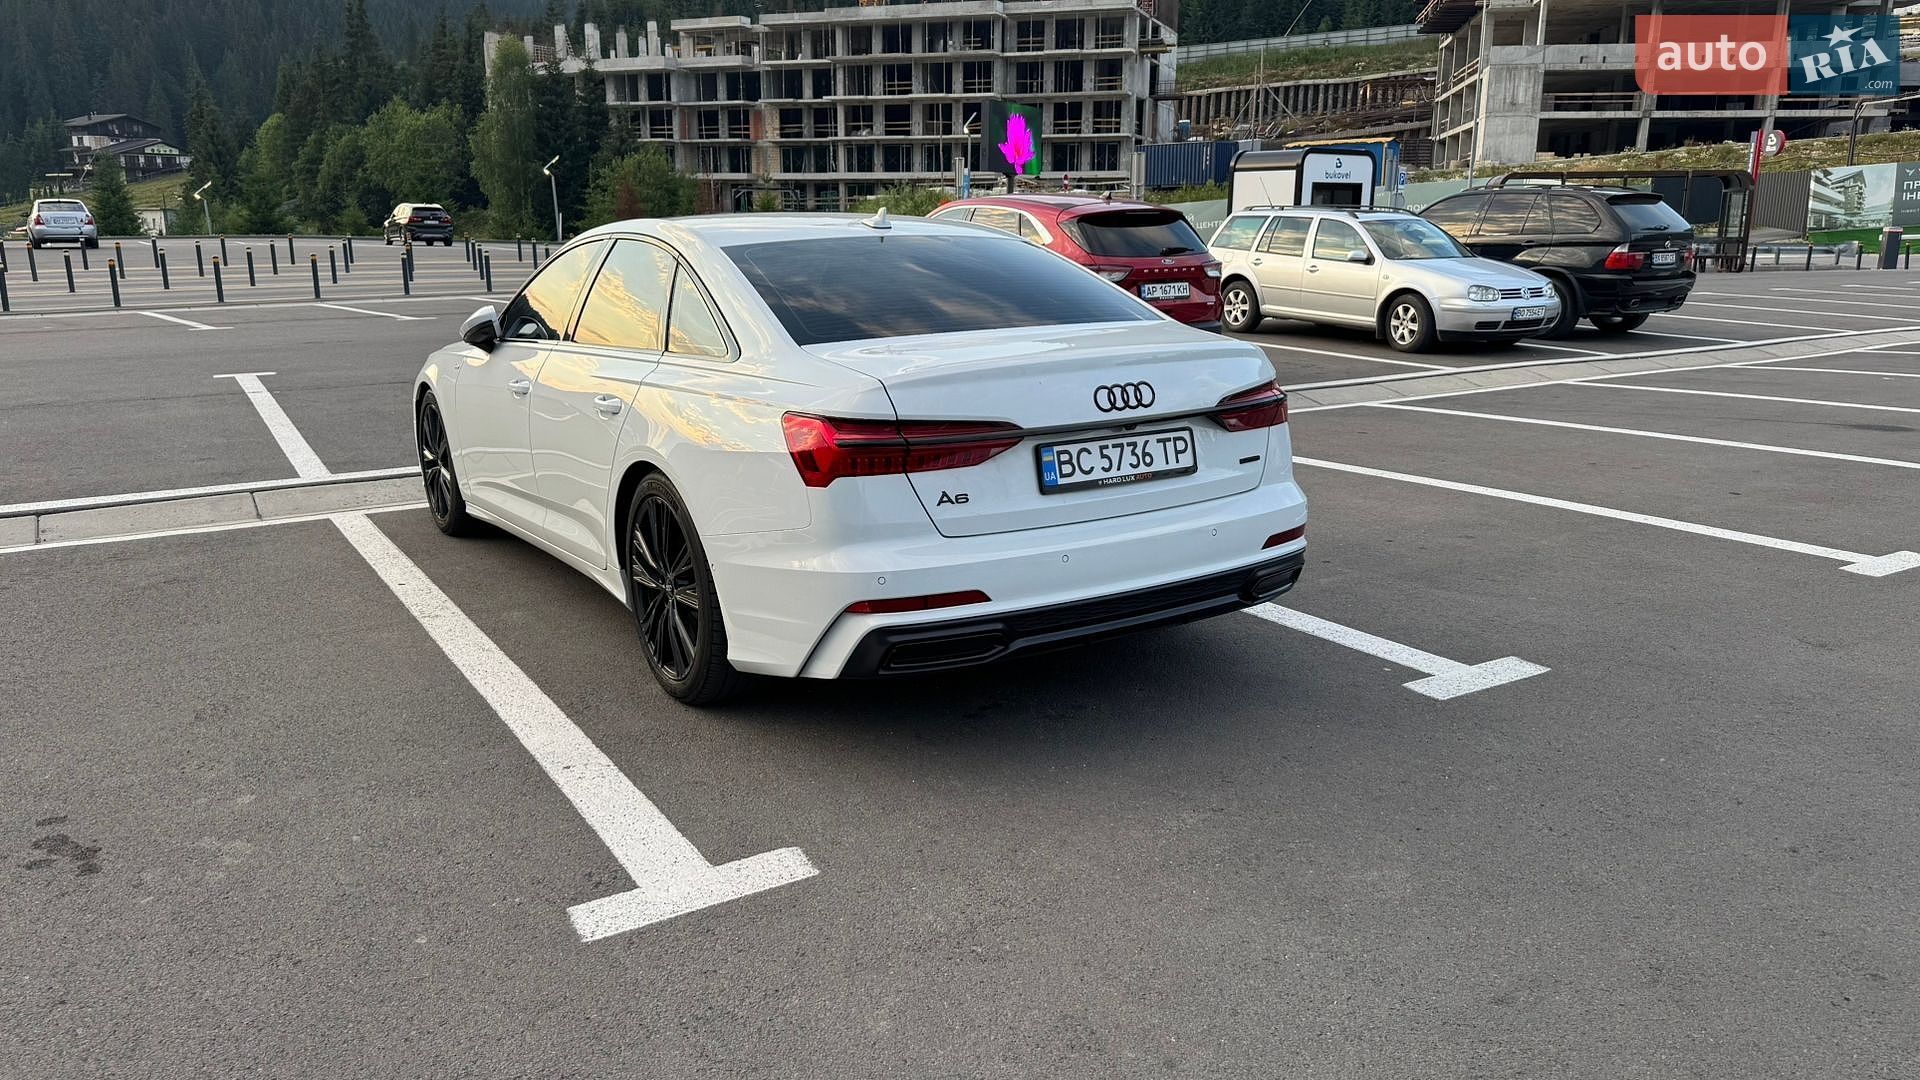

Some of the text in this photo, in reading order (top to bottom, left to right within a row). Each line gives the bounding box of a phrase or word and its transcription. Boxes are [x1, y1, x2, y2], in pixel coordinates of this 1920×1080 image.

[1325, 170, 1351, 179] bukovel
[1146, 284, 1188, 297] AP 1671 KH
[1056, 436, 1189, 479] BC 5736 TP
[1044, 471, 1056, 481] UA
[936, 490, 969, 506] A6
